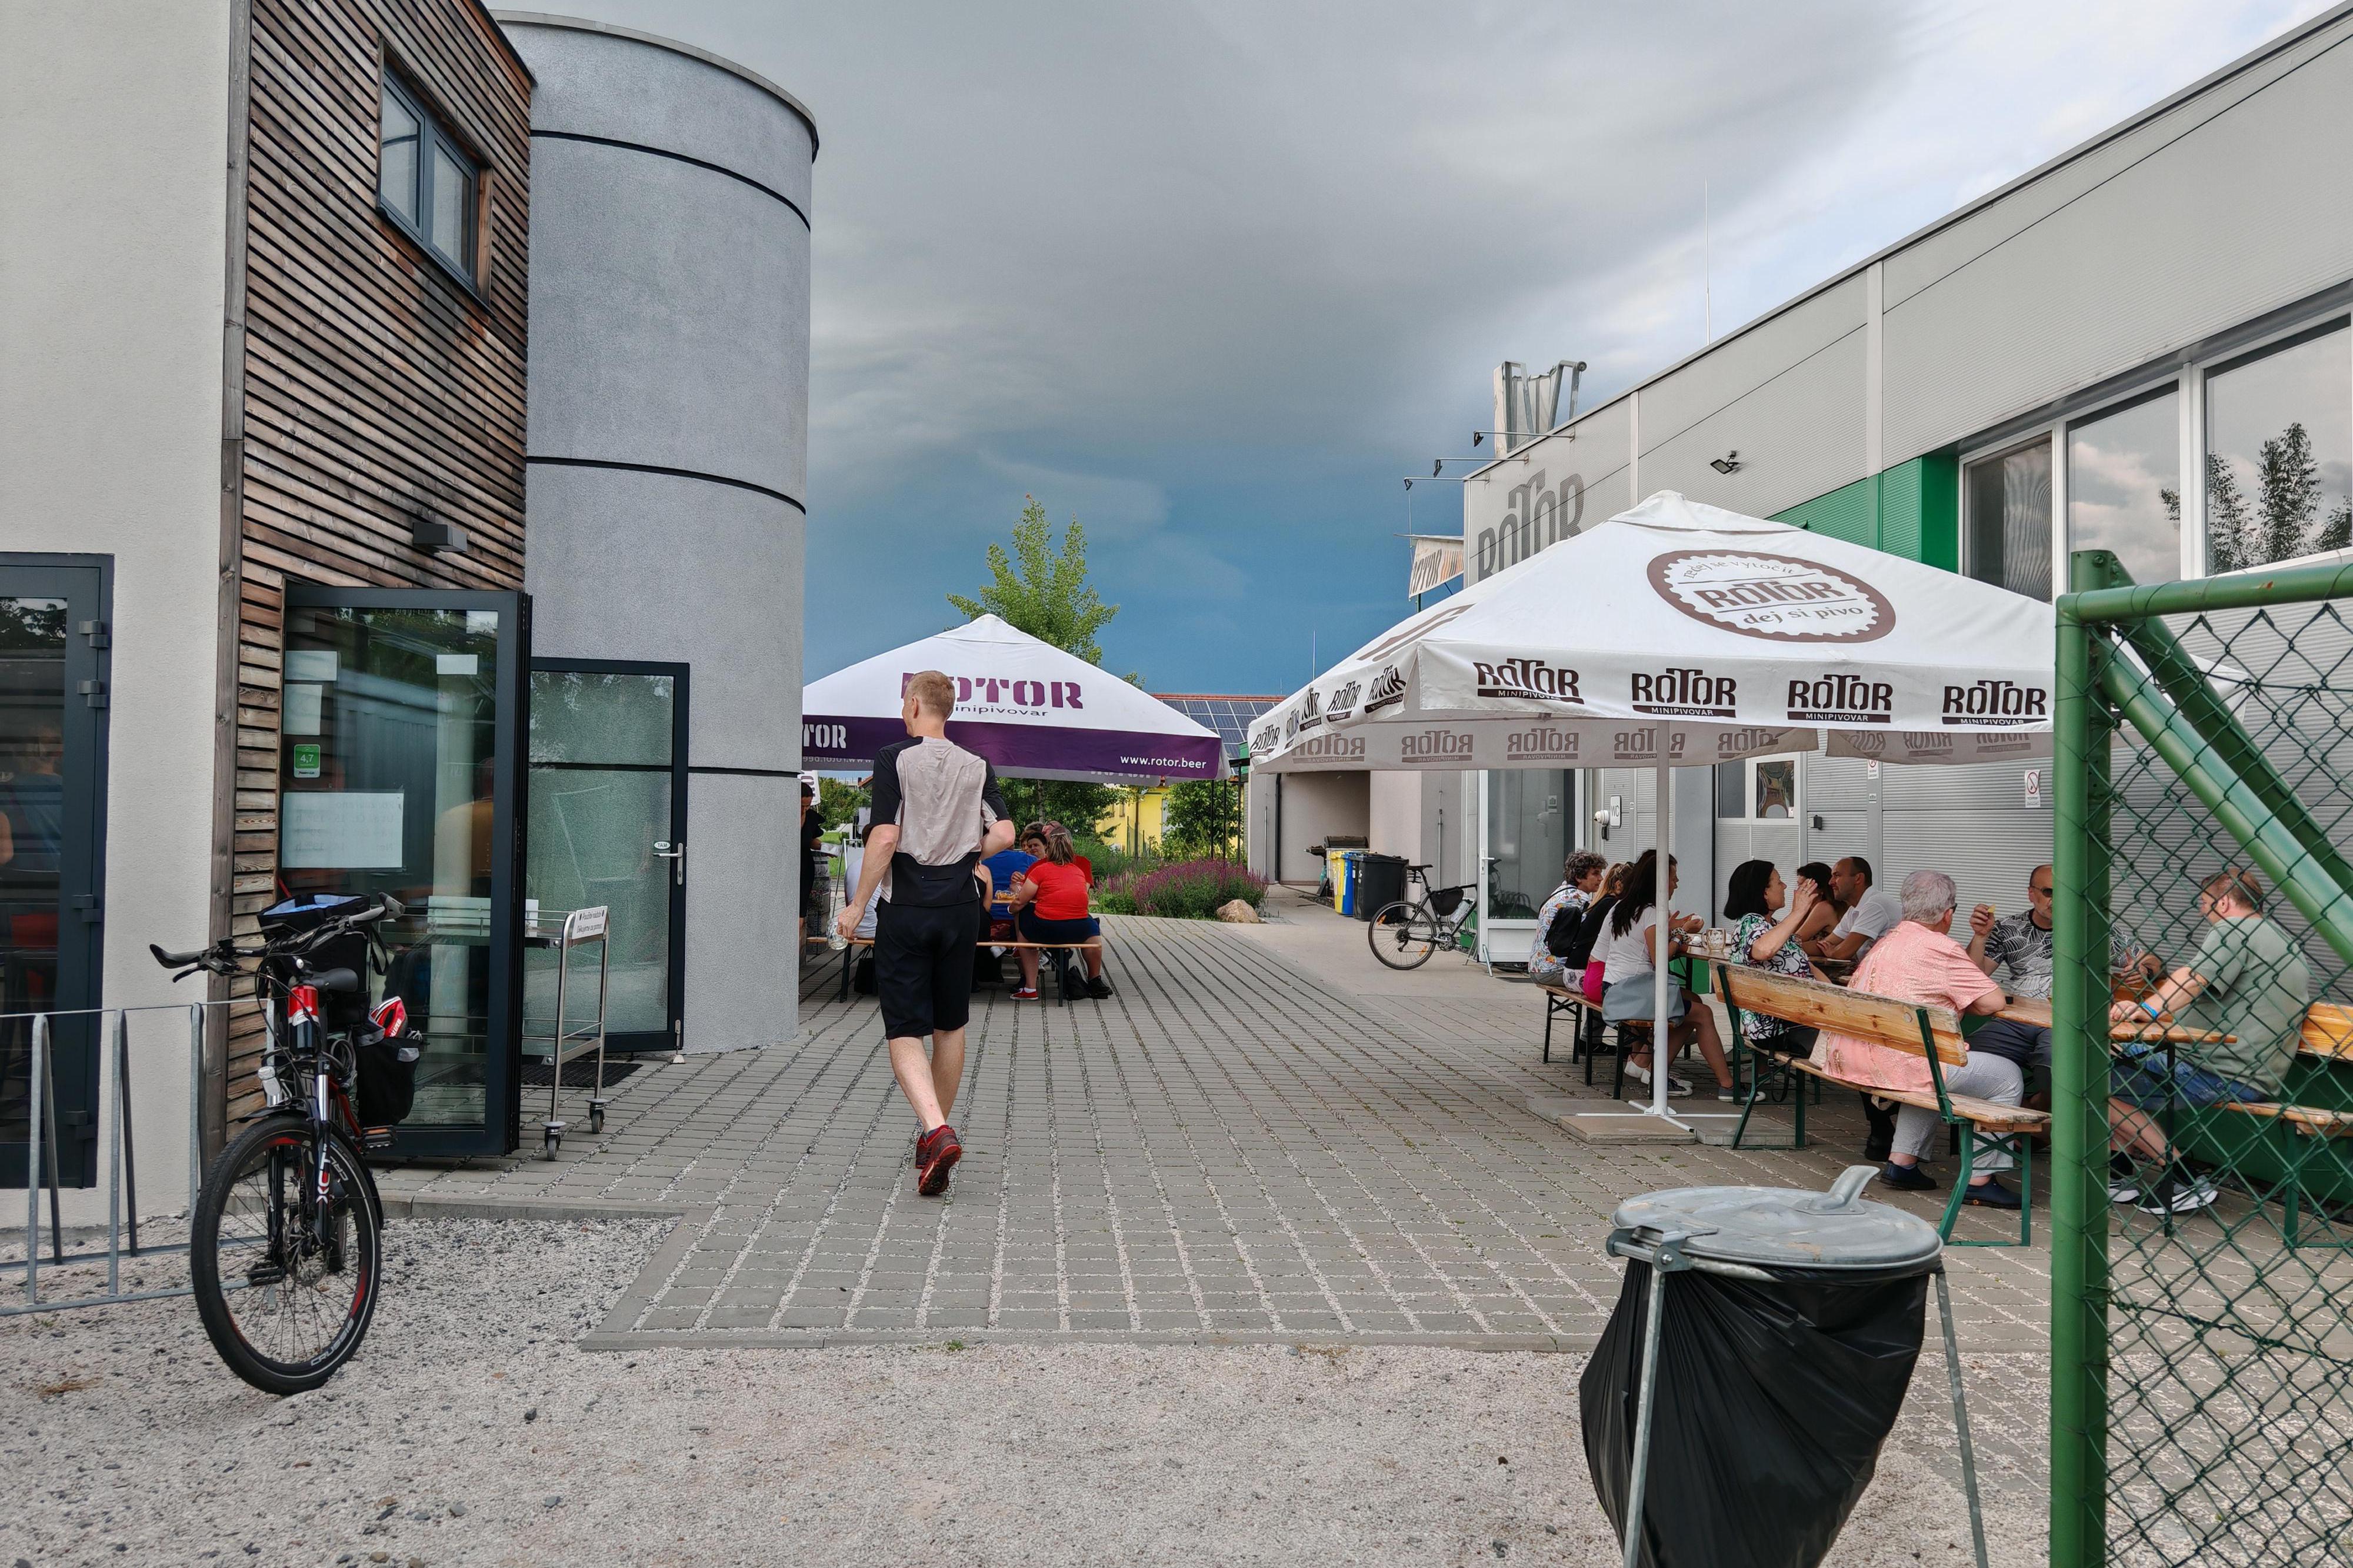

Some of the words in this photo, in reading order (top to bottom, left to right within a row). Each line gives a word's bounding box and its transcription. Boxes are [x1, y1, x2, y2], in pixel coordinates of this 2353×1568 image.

[1478, 468, 1584, 582] ROTOR
[1693, 581, 1847, 608] ROTOR
[1743, 610, 1783, 623] dej
[1788, 608, 1811, 618] si
[1813, 607, 1864, 619] pivo
[901, 672, 1084, 709] OTOR
[1367, 664, 1407, 702] ROTOR
[1473, 658, 1579, 698] ROTOR
[1632, 668, 1737, 706] ROTOR
[1327, 680, 1361, 712] ROTOR
[1788, 674, 1893, 711] ROTOR
[1942, 680, 2047, 715] ROTOR
[955, 704, 1049, 717] inipivovar
[1651, 707, 1714, 716] MINIPIVOVAR
[1805, 713, 1869, 722] MINIPIVOVAR
[801, 723, 846, 749] TOR
[1250, 724, 1280, 751] ROTOR
[300, 754, 314, 763] 4,7
[1120, 756, 1207, 769] www.rotor.beer
[1611, 805, 1619, 818] WC
[315, 1152, 331, 1205] XCT
